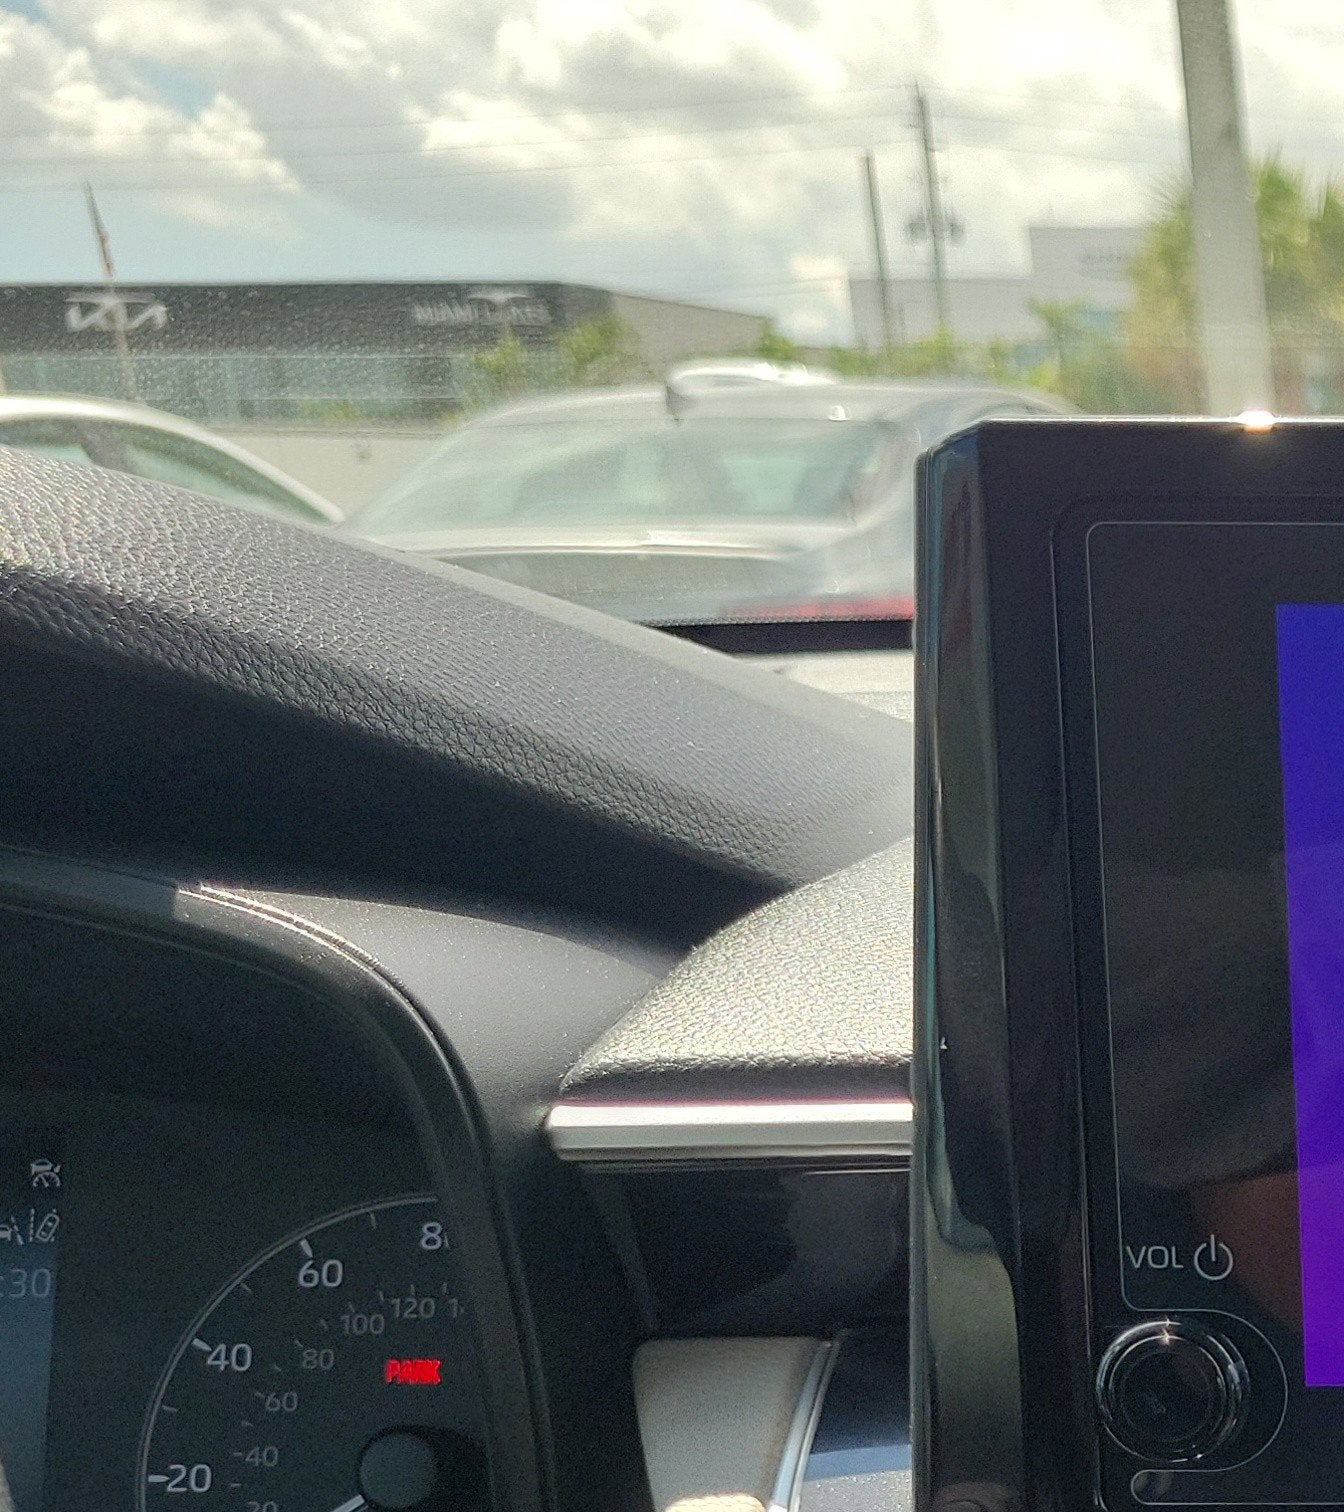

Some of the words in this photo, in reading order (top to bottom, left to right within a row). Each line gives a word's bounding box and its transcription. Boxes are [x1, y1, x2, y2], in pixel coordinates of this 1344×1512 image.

[421, 1222, 449, 1250] 8
[1126, 1245, 1184, 1269] VOL
[298, 1259, 344, 1288] 60
[390, 1298, 436, 1319] 120
[341, 1313, 385, 1335] 100
[206, 1342, 253, 1372] 40
[302, 1349, 335, 1370] 80
[265, 1391, 299, 1412] 60
[245, 1446, 279, 1467] 40
[166, 1463, 213, 1493] 20
